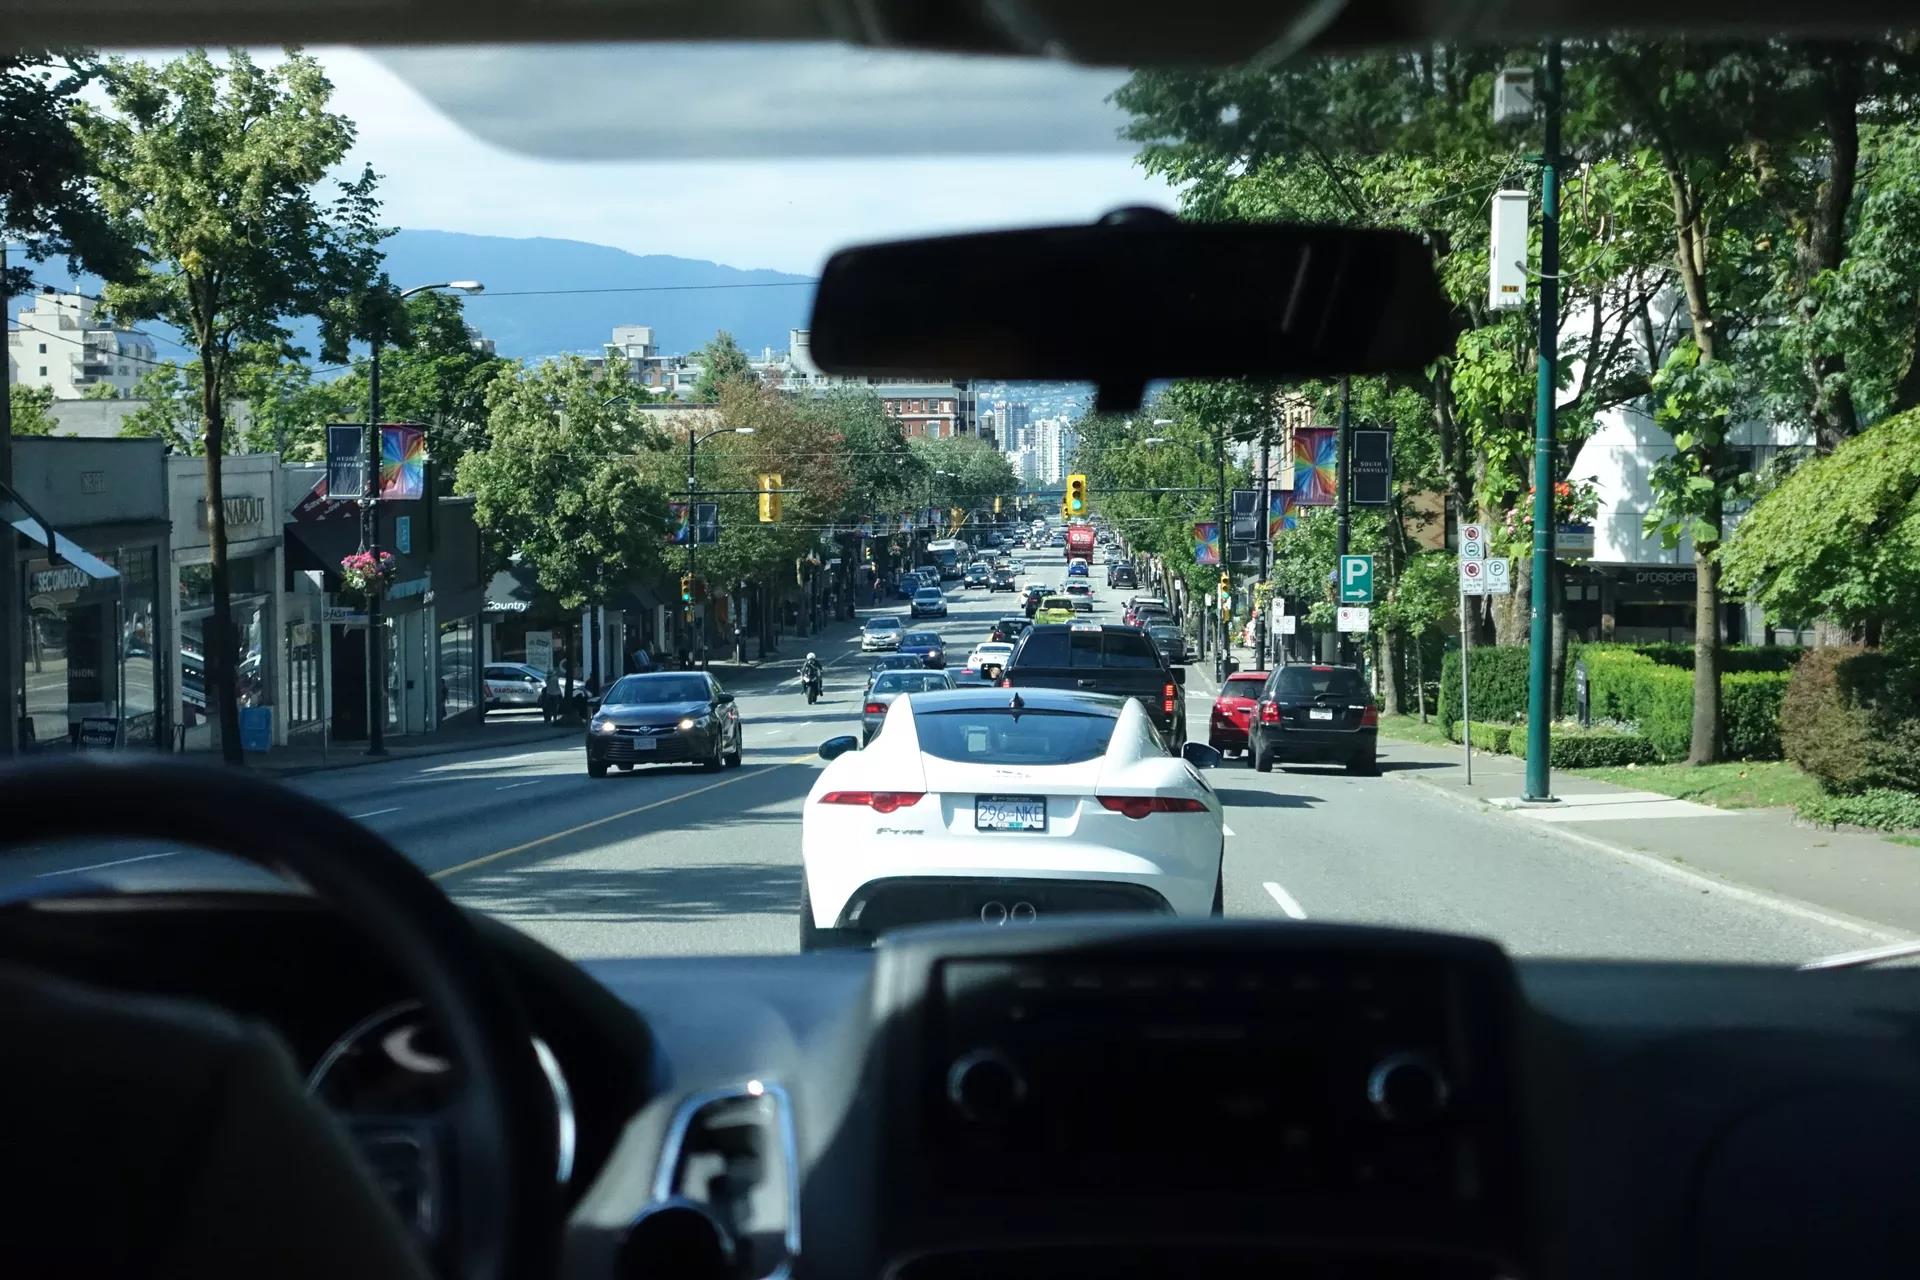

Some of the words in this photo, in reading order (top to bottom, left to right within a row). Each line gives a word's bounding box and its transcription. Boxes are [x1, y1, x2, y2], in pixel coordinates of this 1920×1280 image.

[37, 571, 68, 592] SECOND
[1346, 559, 1369, 586] P
[1636, 571, 1696, 585] prospera
